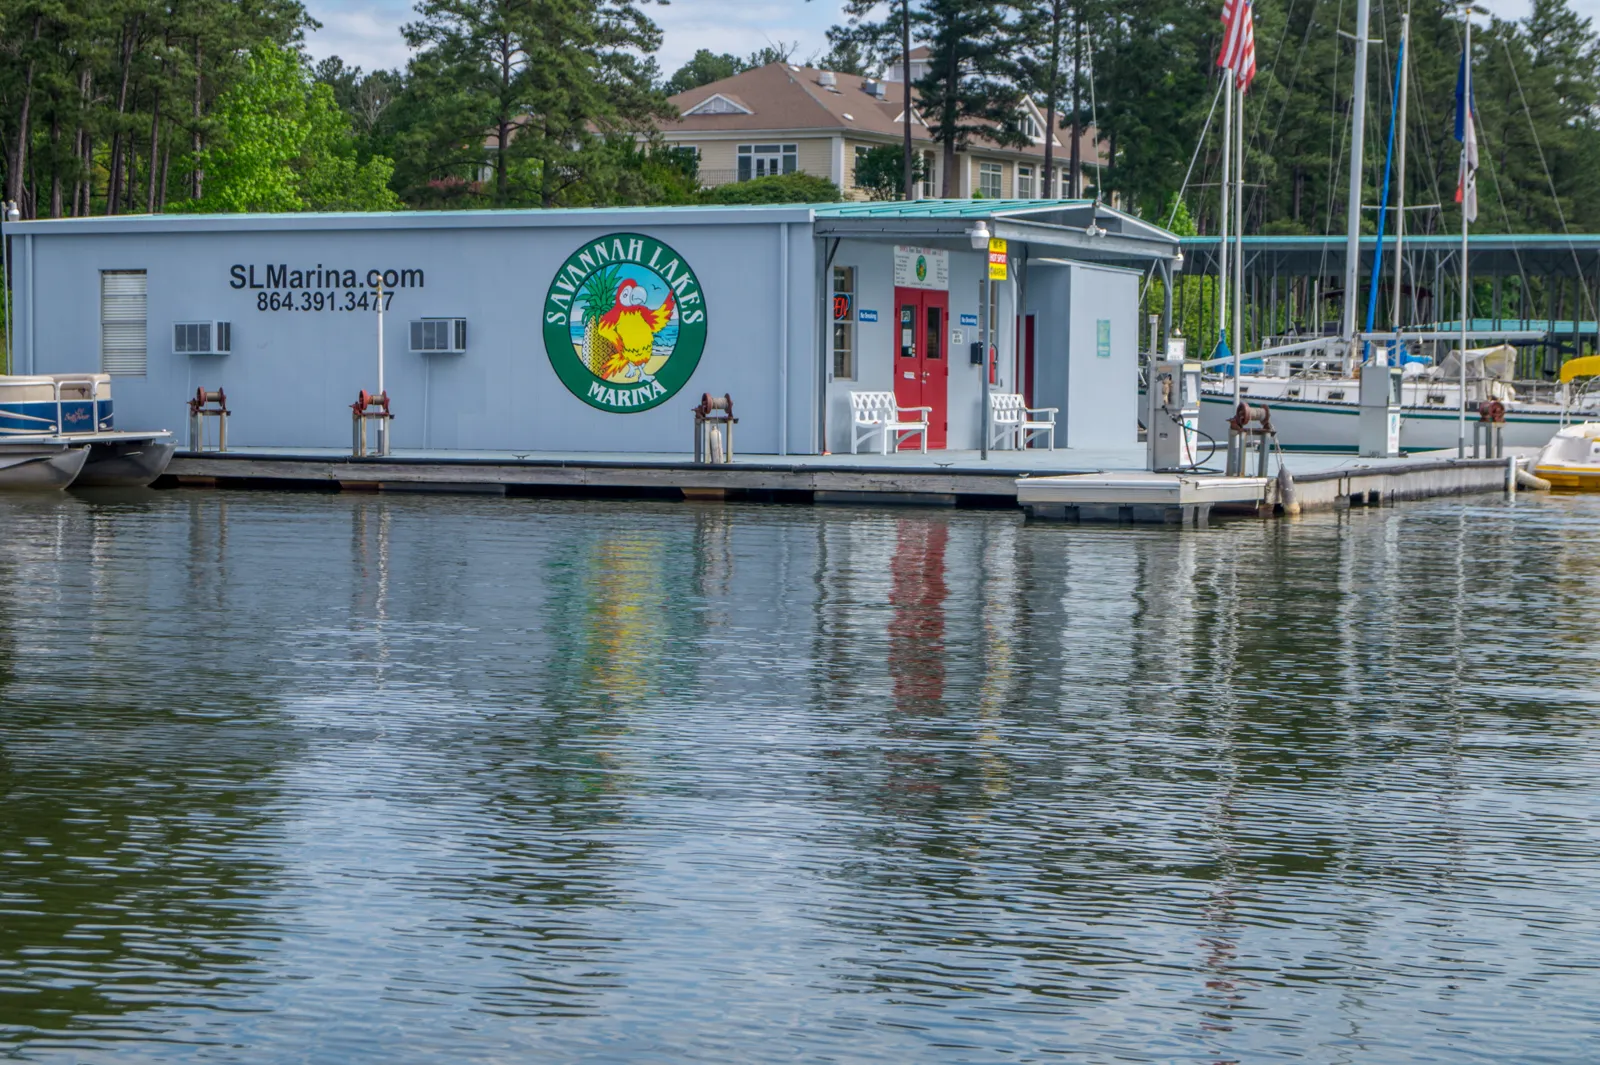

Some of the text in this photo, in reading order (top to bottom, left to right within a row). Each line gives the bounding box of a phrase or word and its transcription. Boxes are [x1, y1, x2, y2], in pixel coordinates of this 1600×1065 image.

[229, 263, 424, 289] SLMarina.com
[546, 238, 704, 326] SAVANNAH LAKES
[257, 291, 395, 312] 864.391.3477
[587, 380, 668, 407] MARINA
